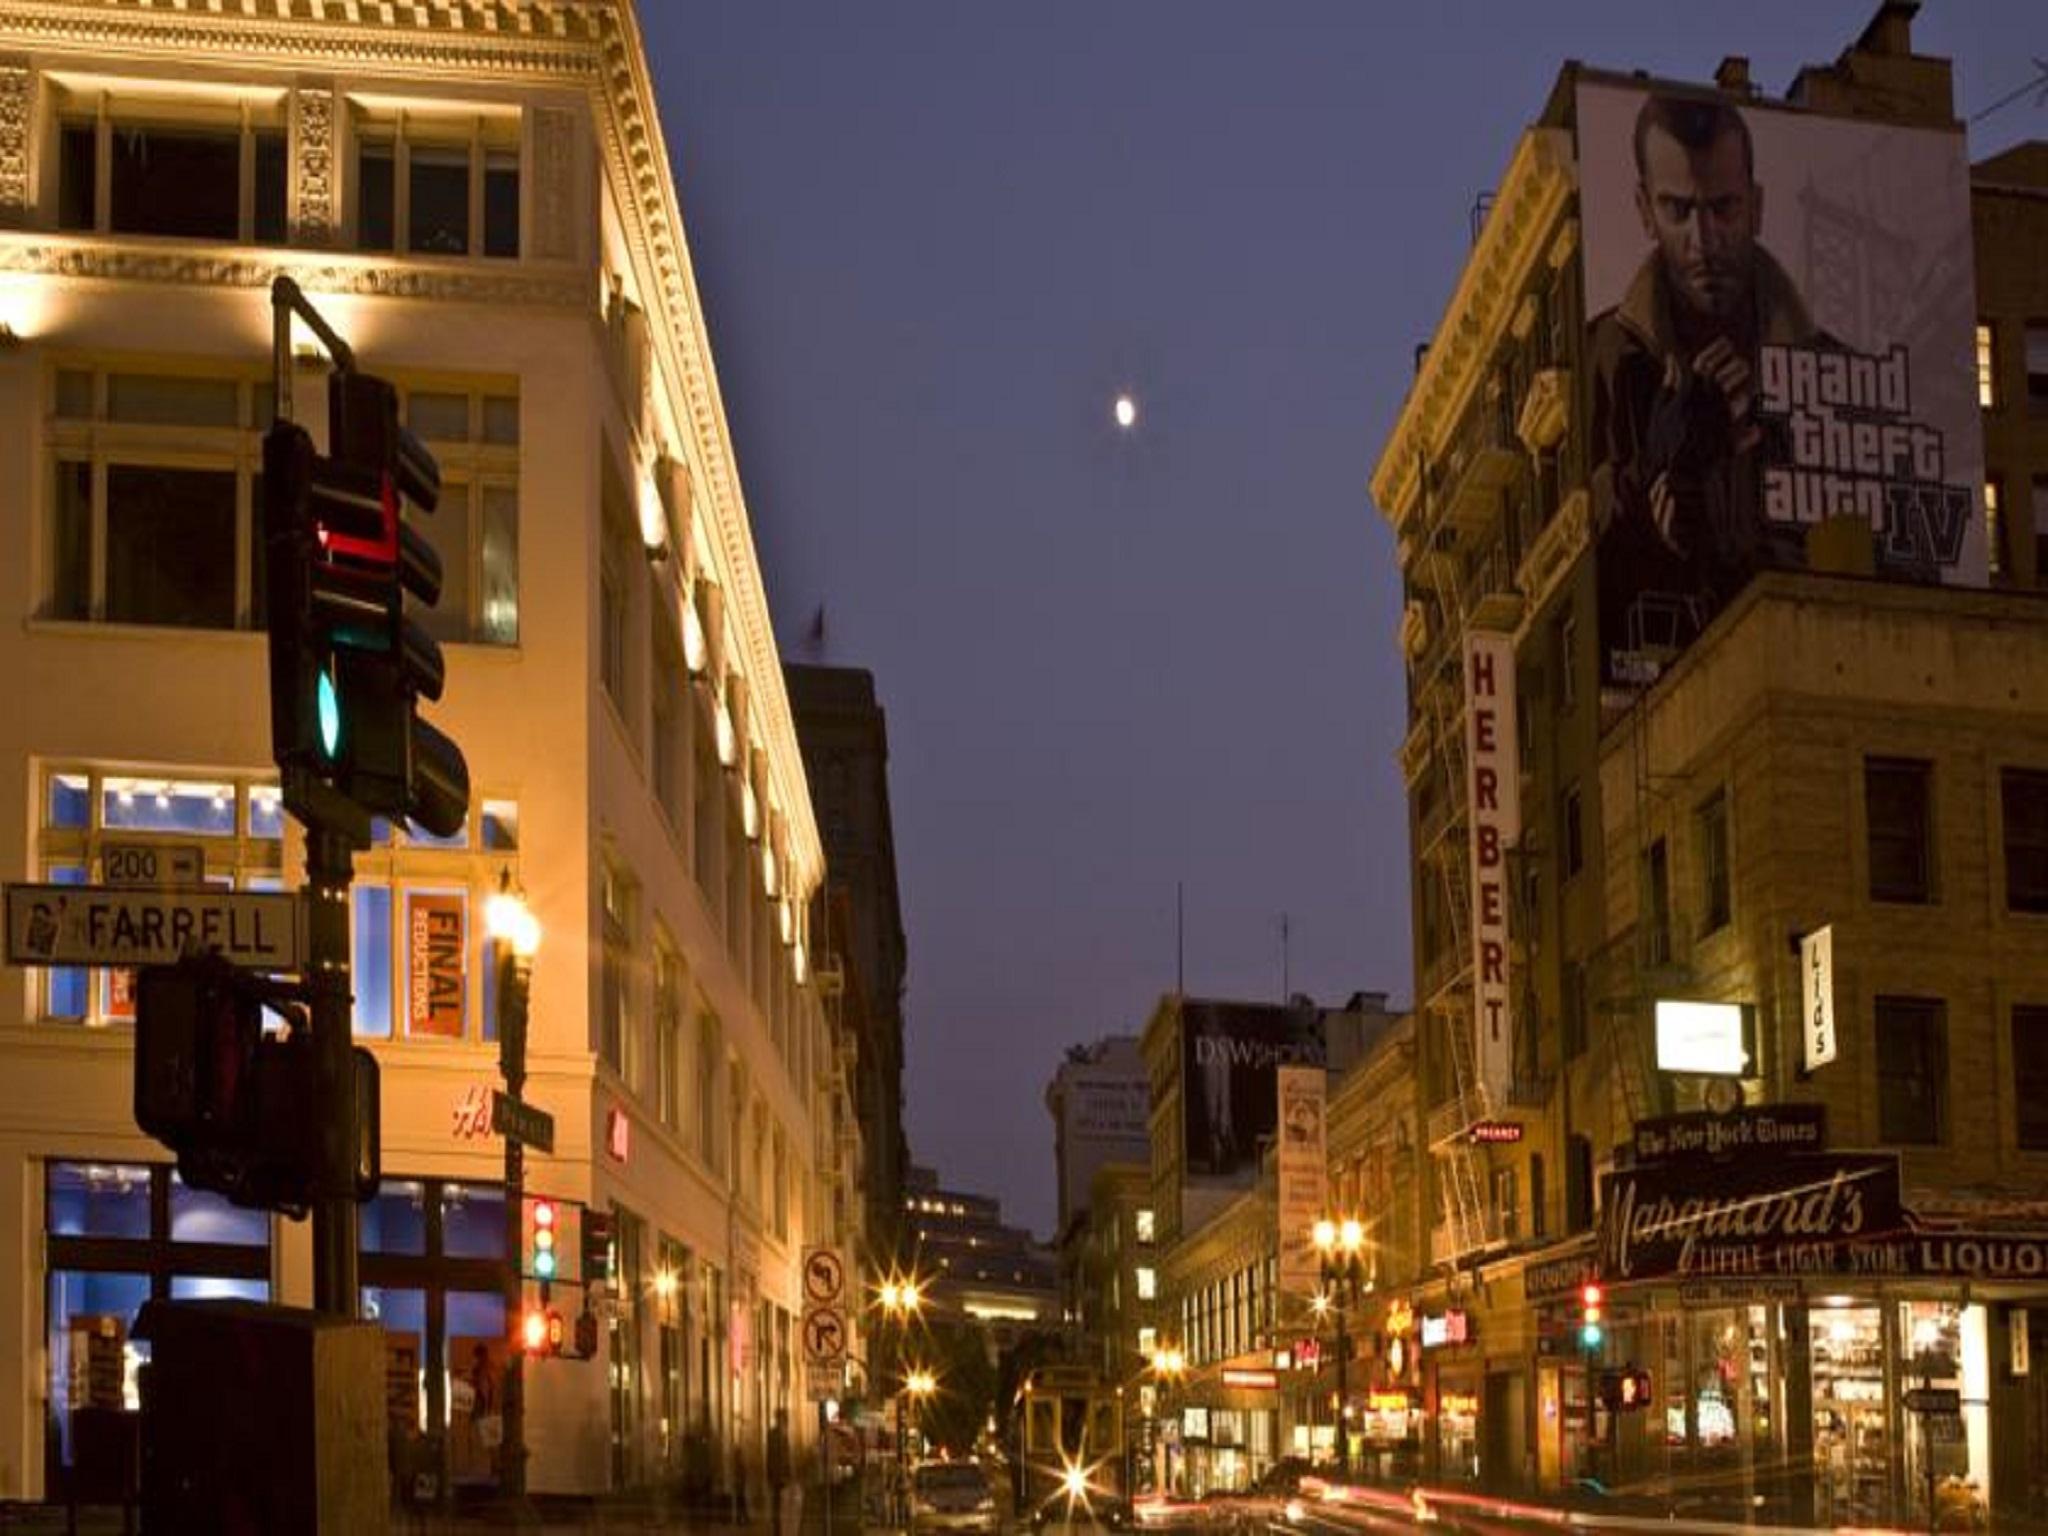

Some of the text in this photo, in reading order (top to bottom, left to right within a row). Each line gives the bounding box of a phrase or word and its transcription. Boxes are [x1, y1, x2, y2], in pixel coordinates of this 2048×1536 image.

[1886, 484, 1972, 564] IV
[109, 850, 157, 879] 200
[1472, 652, 1504, 1042] HERBERT
[428, 910, 460, 1018] FINAL
[1705, 1118, 1753, 1152] York
[1756, 1117, 1817, 1144] Times
[1606, 1169, 1864, 1276] Marquard's
[1922, 1241, 2048, 1277] LIQUO
